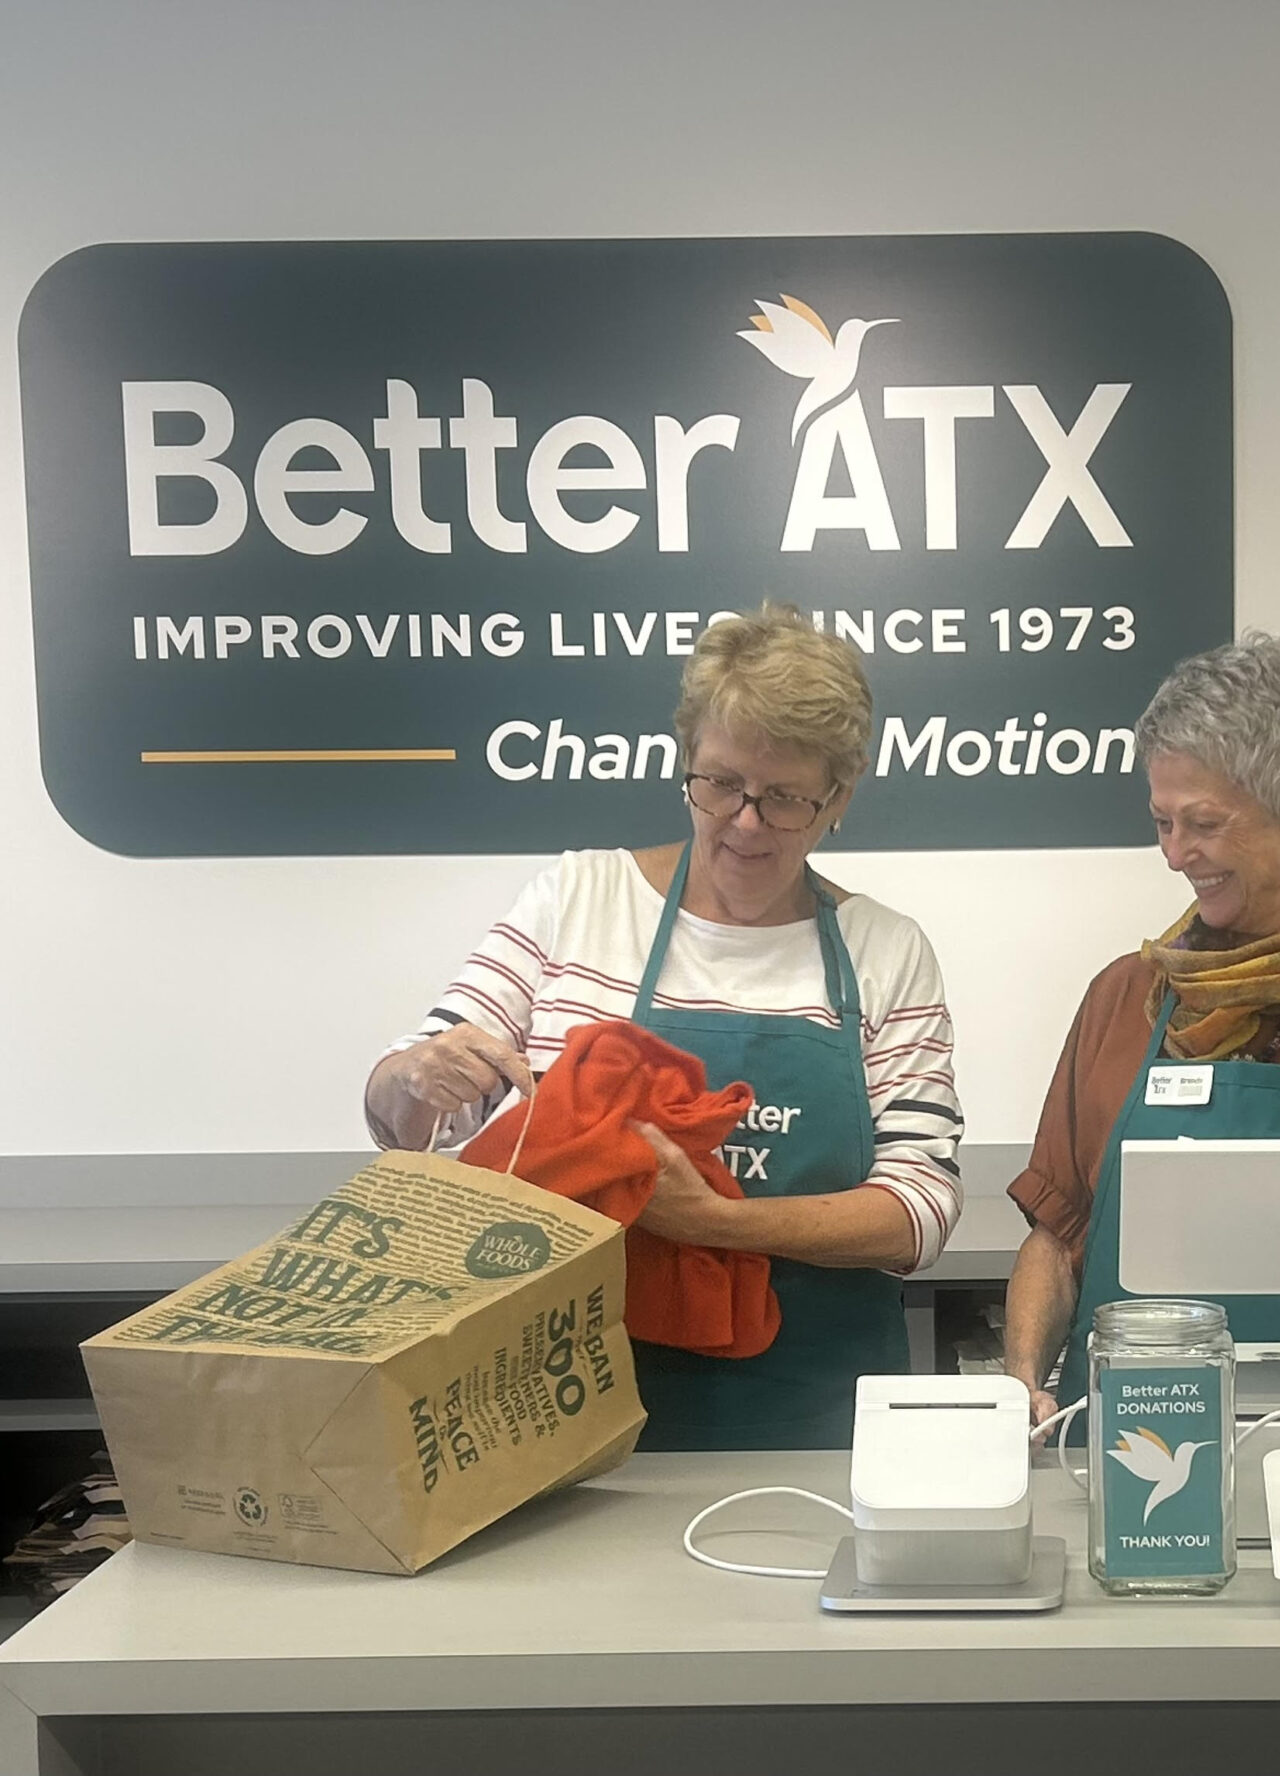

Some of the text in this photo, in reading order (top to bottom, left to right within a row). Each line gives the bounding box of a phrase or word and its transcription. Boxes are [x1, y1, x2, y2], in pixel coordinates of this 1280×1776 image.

[121, 378, 1134, 556] Better ATX
[134, 613, 525, 659] IMPROVING
[550, 611, 742, 657] LIVE
[990, 606, 1136, 652] 1973
[486, 712, 1136, 781] Chan Motion
[736, 1099, 801, 1134] ter
[289, 1199, 403, 1258] IT'S
[484, 1234, 542, 1259] WHOLE
[475, 1248, 532, 1271] FOODS
[195, 1283, 328, 1328] NOT
[543, 1298, 586, 1417] 300
[584, 1283, 615, 1396] WE BAN
[494, 1346, 523, 1447] INGREDIENTS
[507, 1382, 528, 1420] FOOD
[1116, 1400, 1206, 1415] DONATIONS
[1122, 1383, 1200, 1398] Better ATX
[409, 1395, 440, 1494] MIND
[445, 1376, 480, 1472] PEACE
[535, 1424, 546, 1439] &
[1119, 1534, 1210, 1549] THANK YOU!
